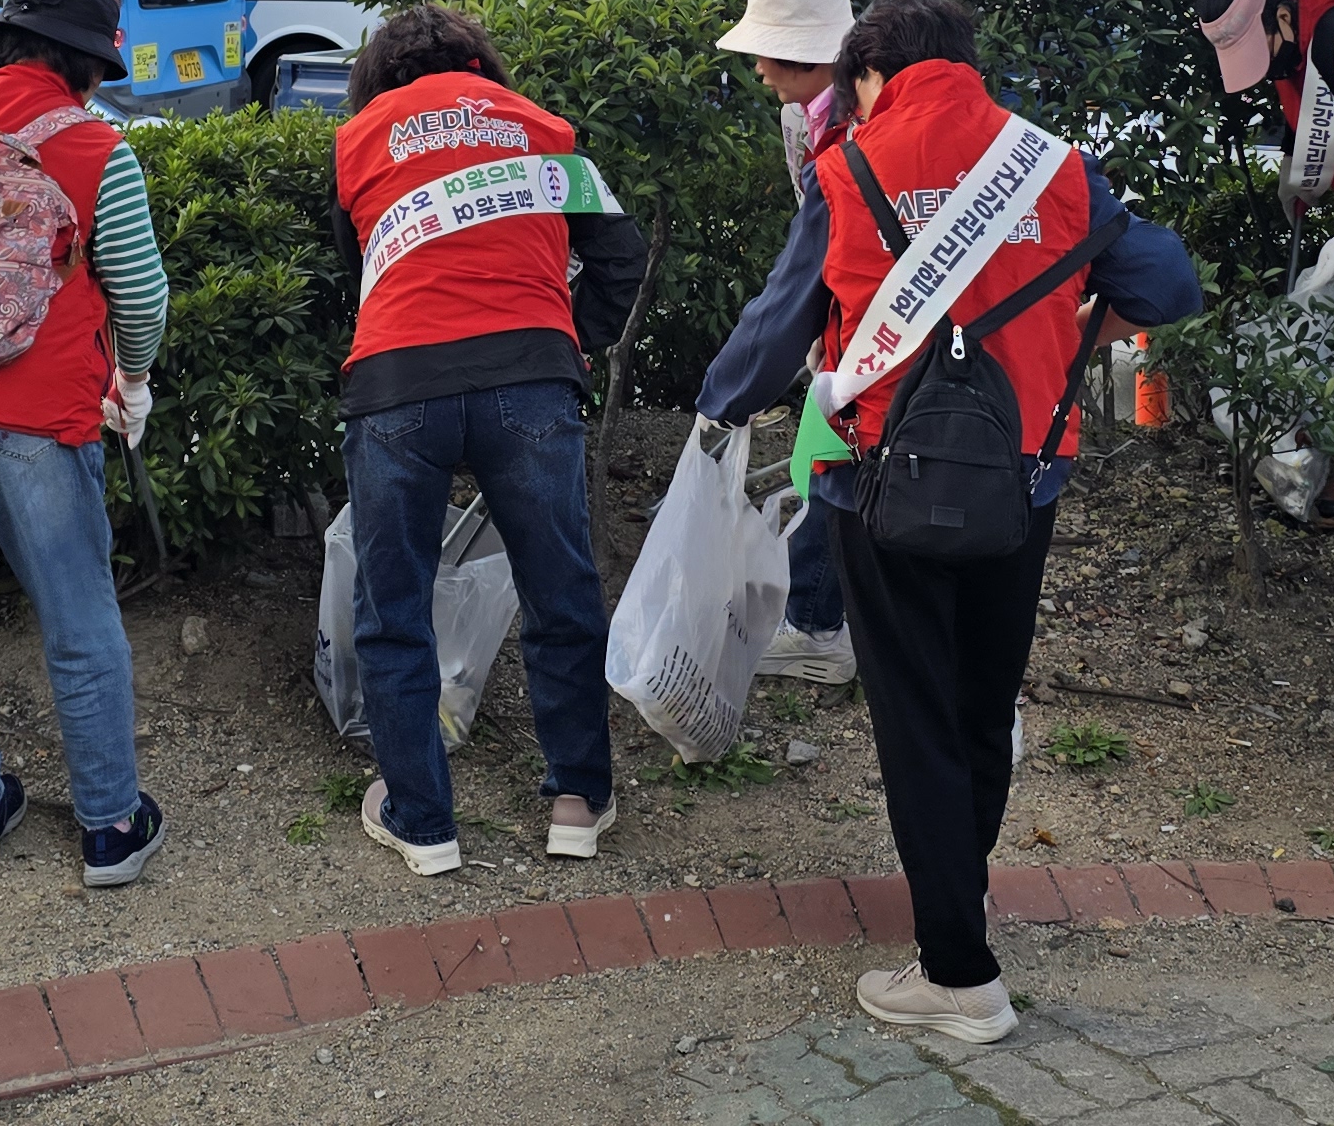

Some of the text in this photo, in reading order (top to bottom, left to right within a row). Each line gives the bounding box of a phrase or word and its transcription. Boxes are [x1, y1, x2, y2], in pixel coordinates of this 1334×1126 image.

[388, 107, 473, 146] MEDI
[389, 128, 529, 163] 한국건강관리협회
[1299, 77, 1334, 190] 건강관리협회
[442, 160, 528, 198] 같이해요
[886, 188, 956, 222] MED
[374, 188, 535, 276] 함께해요 메디체크
[889, 127, 1052, 324] 한국건강관리협회
